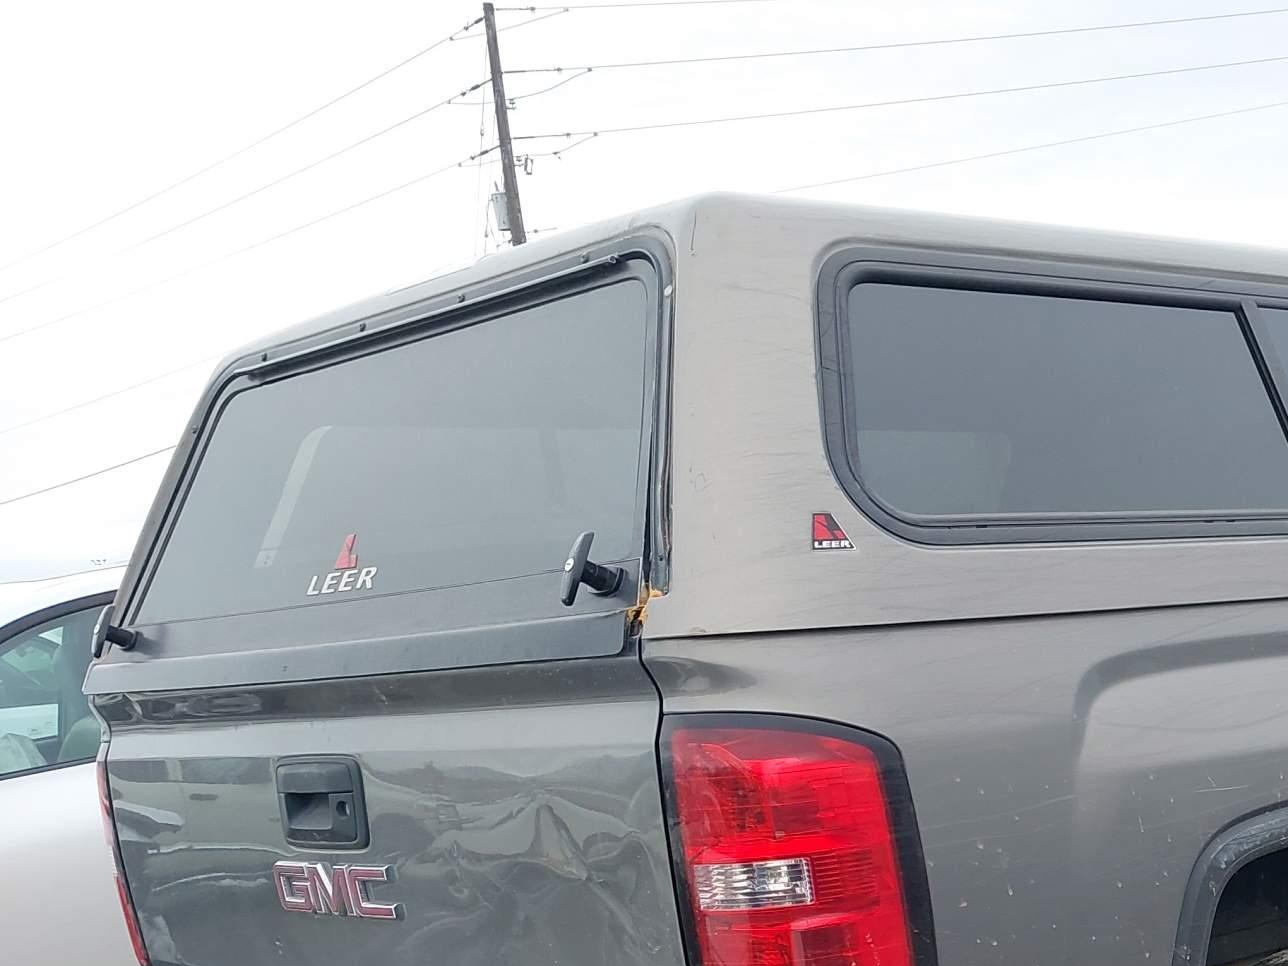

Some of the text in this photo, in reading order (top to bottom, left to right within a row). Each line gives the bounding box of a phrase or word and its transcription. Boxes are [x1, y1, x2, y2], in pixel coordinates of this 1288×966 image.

[813, 540, 852, 549] LEER
[306, 566, 378, 596] LEER
[272, 860, 406, 921] GMC
